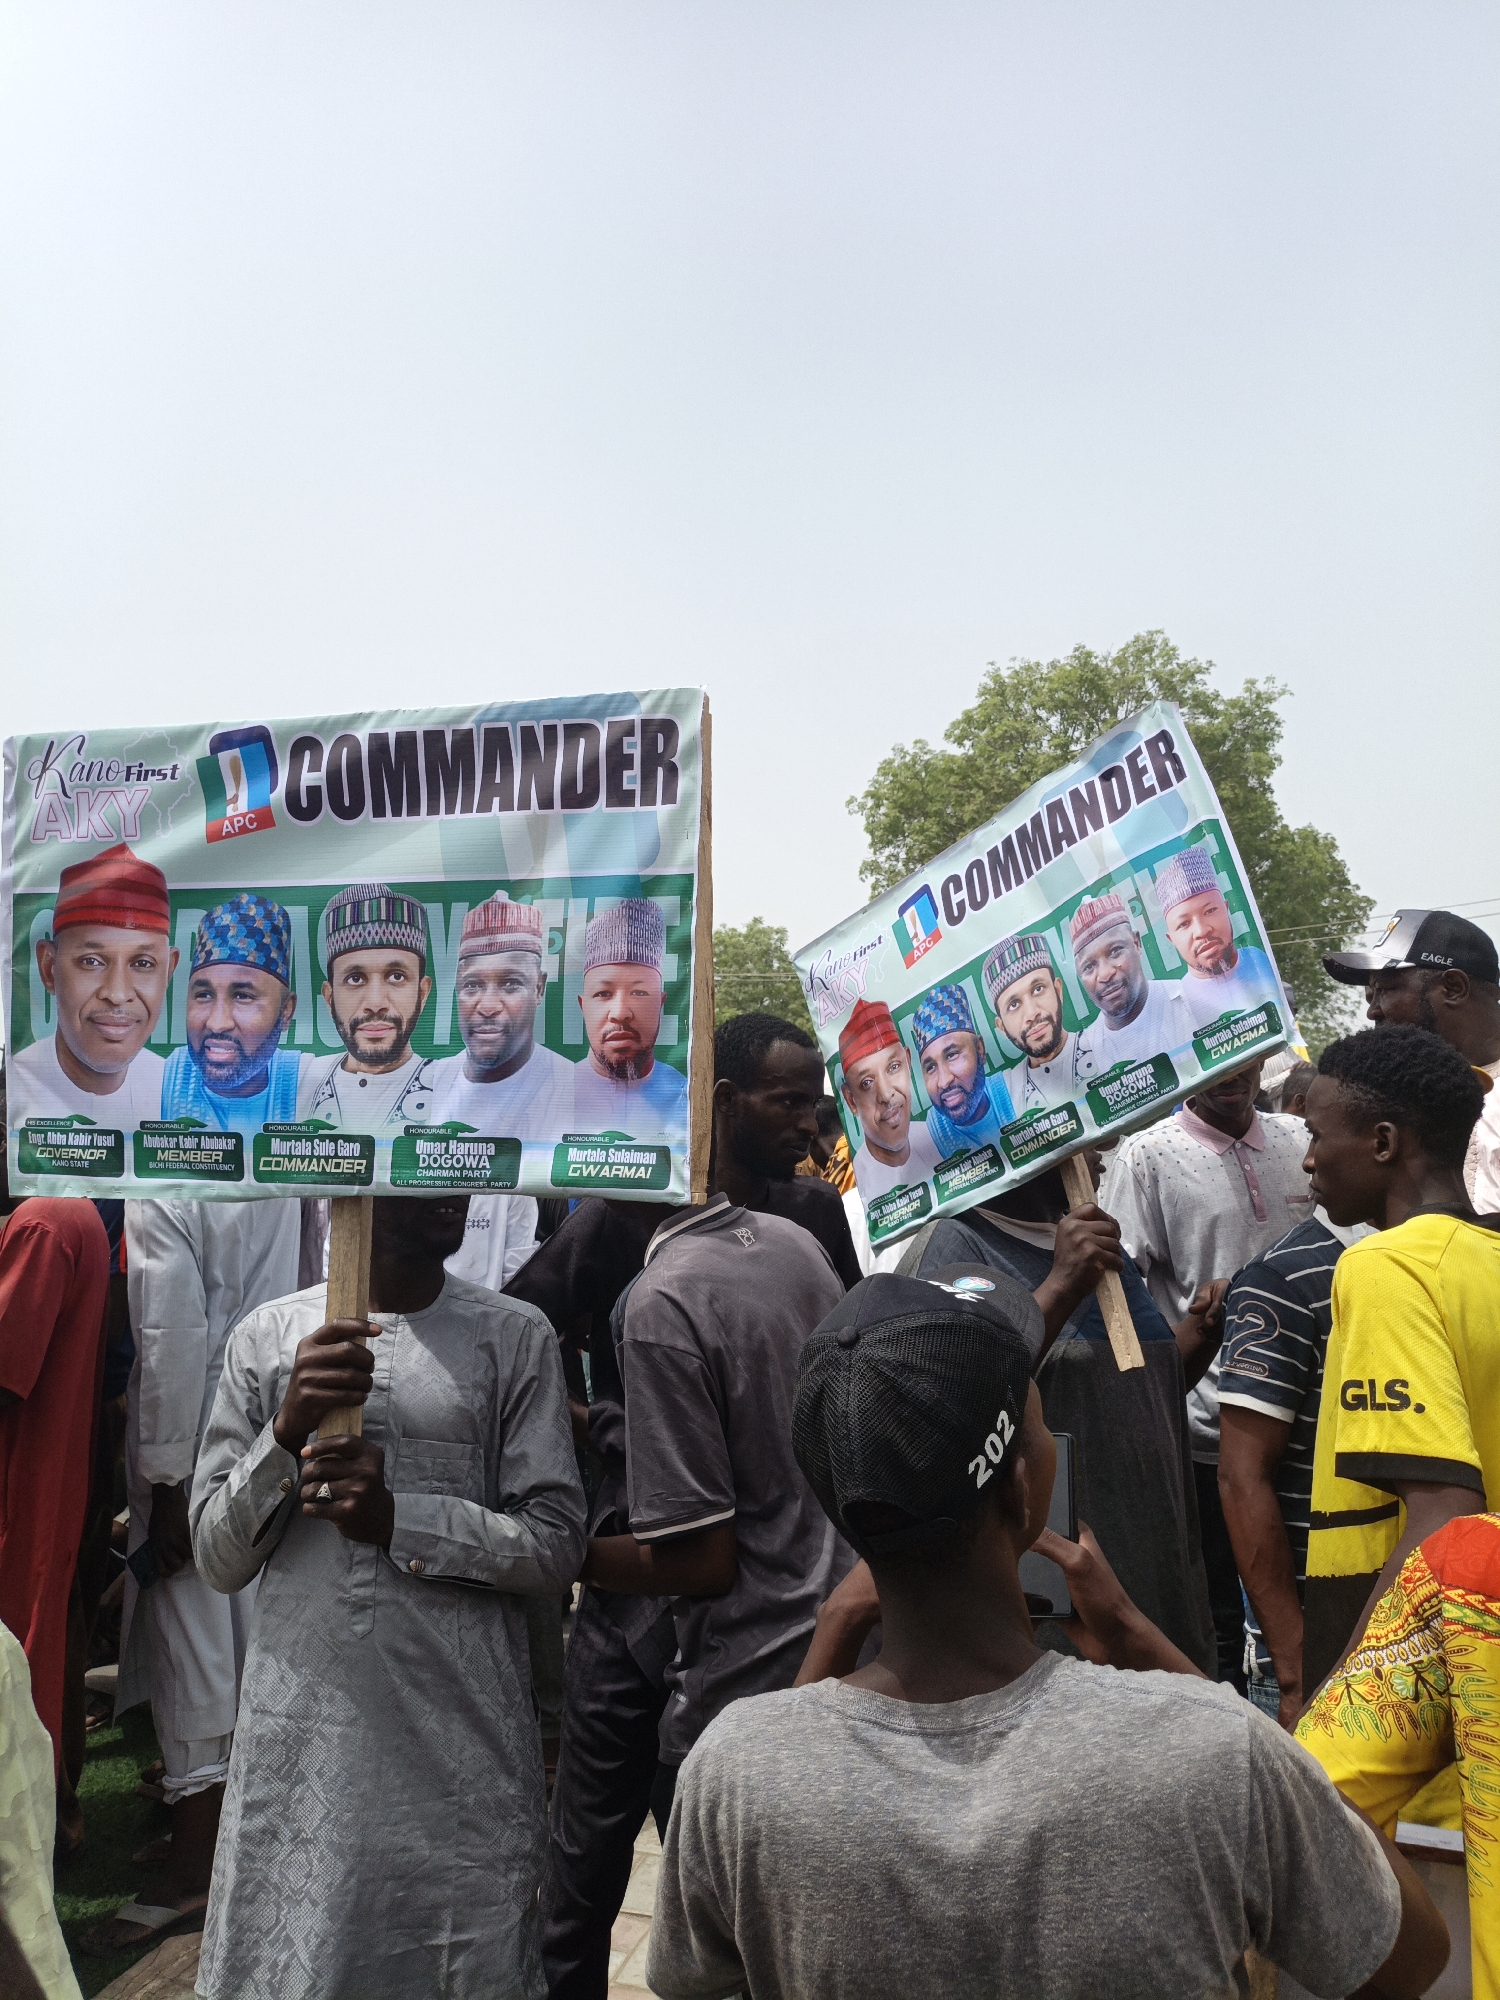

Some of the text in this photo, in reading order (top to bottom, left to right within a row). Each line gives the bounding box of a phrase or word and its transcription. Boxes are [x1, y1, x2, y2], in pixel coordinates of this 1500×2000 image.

[28, 735, 180, 799] Kano First
[285, 717, 679, 821] COMMANDER
[32, 788, 149, 841] AKY
[222, 814, 257, 836] APC
[940, 729, 1187, 926] COMMANDER
[913, 937, 934, 960] APC
[1420, 952, 1454, 967] EAGLE
[804, 934, 884, 1001] Kano First
[818, 958, 868, 1027] AKY
[1202, 1010, 1268, 1050] Murtala Sulaiman
[1210, 1022, 1269, 1060] GWARMAI
[1098, 1063, 1154, 1097] Umar Haruna
[1105, 1074, 1156, 1106] DOGOWA
[1109, 1083, 1159, 1113] CHAIRMAN PARTY
[28, 1131, 46, 1145] Engr.
[47, 1131, 66, 1145] Abba
[68, 1132, 91, 1146] Kabir
[143, 1134, 236, 1150] Abubakar Kabir Abubakar
[1009, 1110, 1069, 1147] Murtala Sule Garo
[1010, 1119, 1077, 1161] COMMANDER
[36, 1147, 107, 1160] GOVERNOR
[156, 1149, 223, 1162] MEMBER
[271, 1138, 360, 1157] Murtala Sule Garo
[415, 1140, 495, 1156] Umar Haruna
[419, 1154, 490, 1168] DOGOWA
[567, 1147, 657, 1165] Murtala Sulaiman
[70, 1160, 89, 1168] STATE
[149, 1161, 235, 1171] BICHI FEDERAL CONSTITUENCY
[259, 1157, 367, 1174] COMMANDER
[416, 1169, 492, 1178] CHAIRMAN PARTY
[568, 1164, 653, 1179] GWARMAI
[948, 1160, 990, 1188] MEMBER
[877, 1199, 920, 1227] GOVERNOR
[1223, 1300, 1280, 1377] 2
[1340, 1378, 1426, 1414] GLS.
[968, 1410, 1015, 1489] 202
